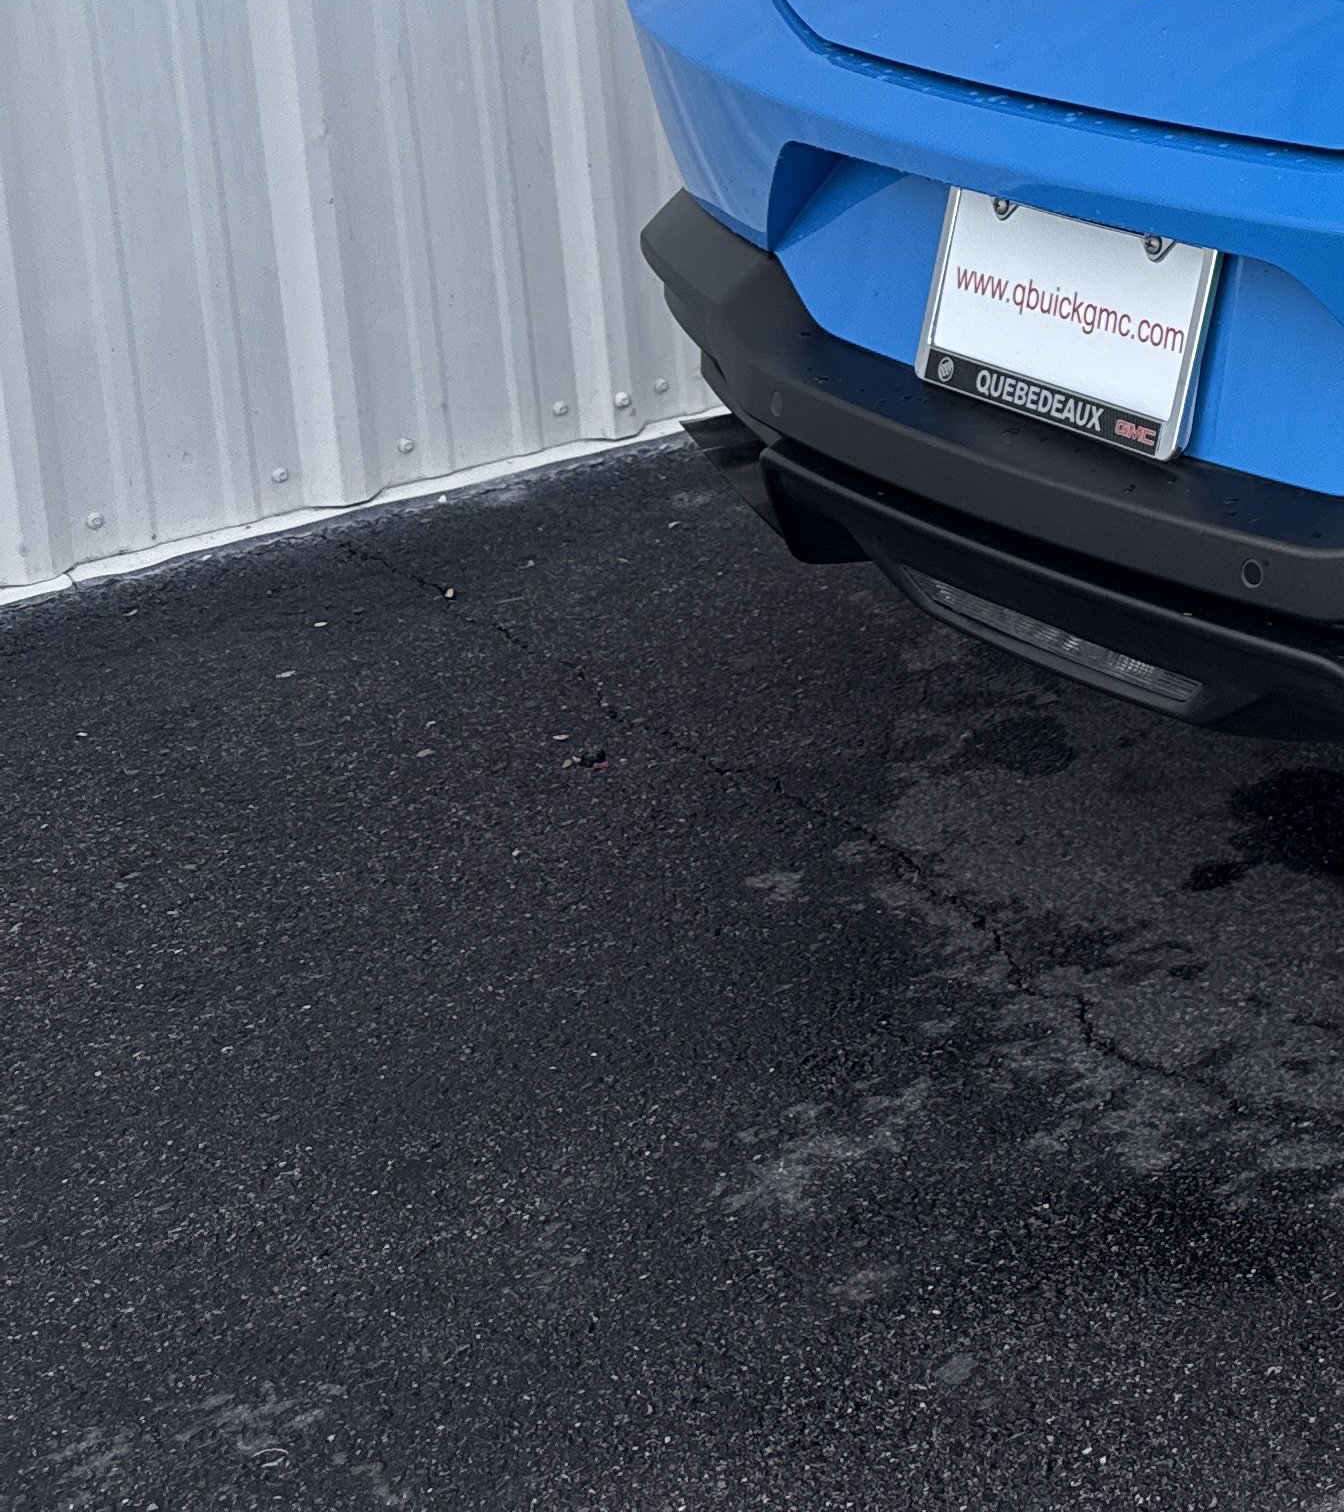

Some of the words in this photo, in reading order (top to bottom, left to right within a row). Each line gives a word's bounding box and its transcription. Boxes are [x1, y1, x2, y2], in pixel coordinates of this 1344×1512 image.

[956, 265, 1185, 354] www.qbuickgmc.com
[975, 368, 1105, 432] QUEBEDEAUX
[1114, 418, 1158, 446] GMC
